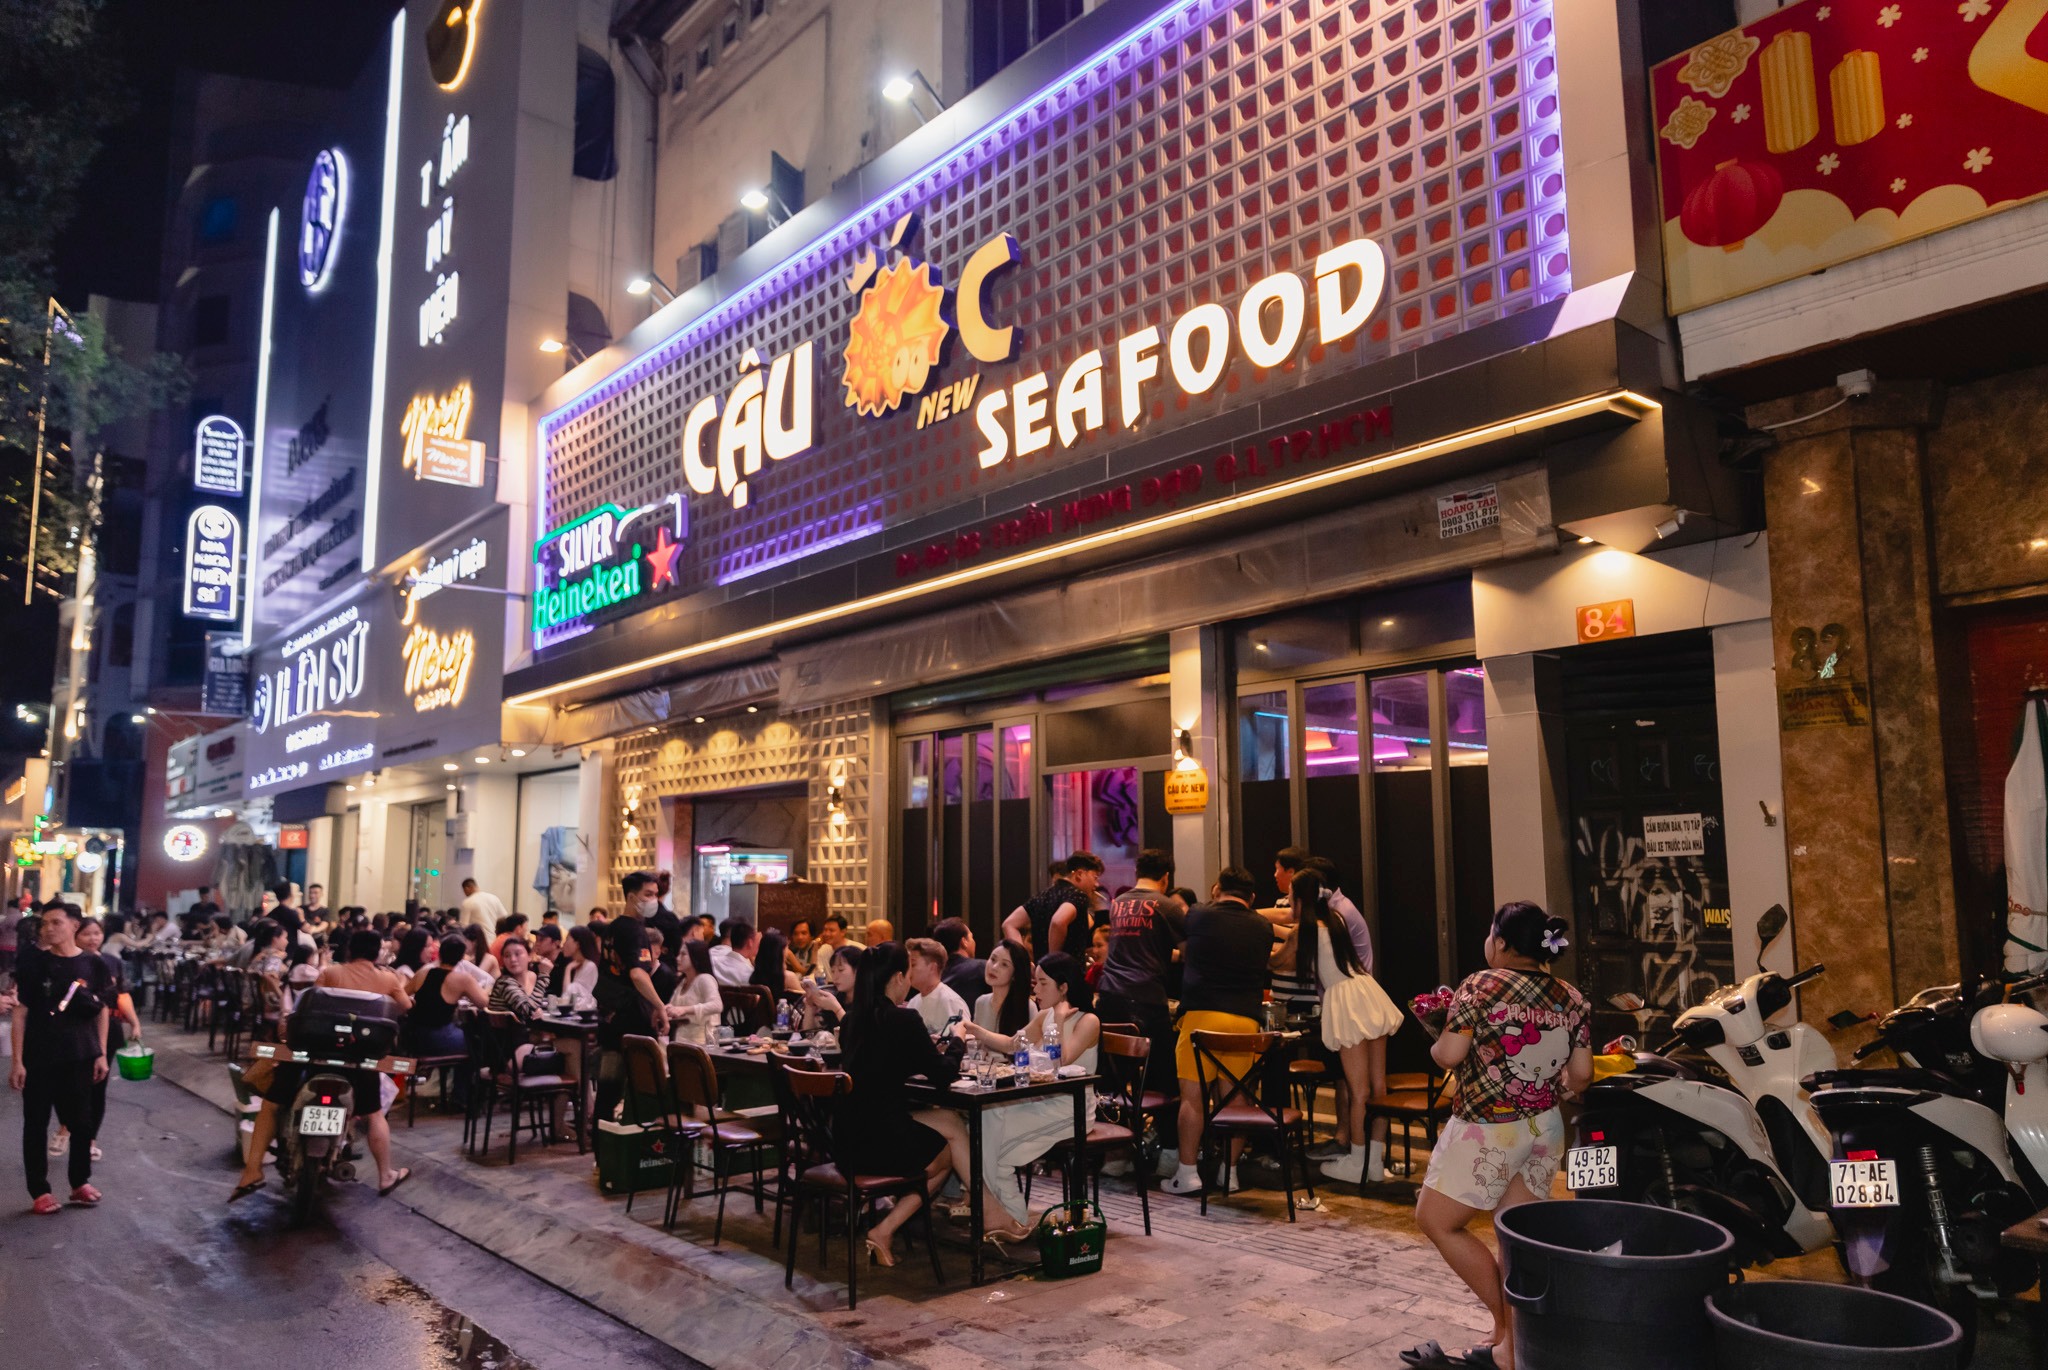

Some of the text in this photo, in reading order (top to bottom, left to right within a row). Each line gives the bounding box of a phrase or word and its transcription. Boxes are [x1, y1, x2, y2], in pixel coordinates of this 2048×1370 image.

[976, 238, 1386, 469] SEAFOOD
[682, 340, 813, 510] CẬU
[917, 373, 980, 431] NEW
[558, 512, 613, 577] SILVER
[532, 557, 641, 632] Heineken
[1584, 604, 1627, 638] 84
[1570, 1166, 1616, 1187] 152.58
[1574, 1148, 1610, 1168] 49-B2
[1838, 1162, 1888, 1183] 71-AE
[1836, 1183, 1894, 1204] 028.84
